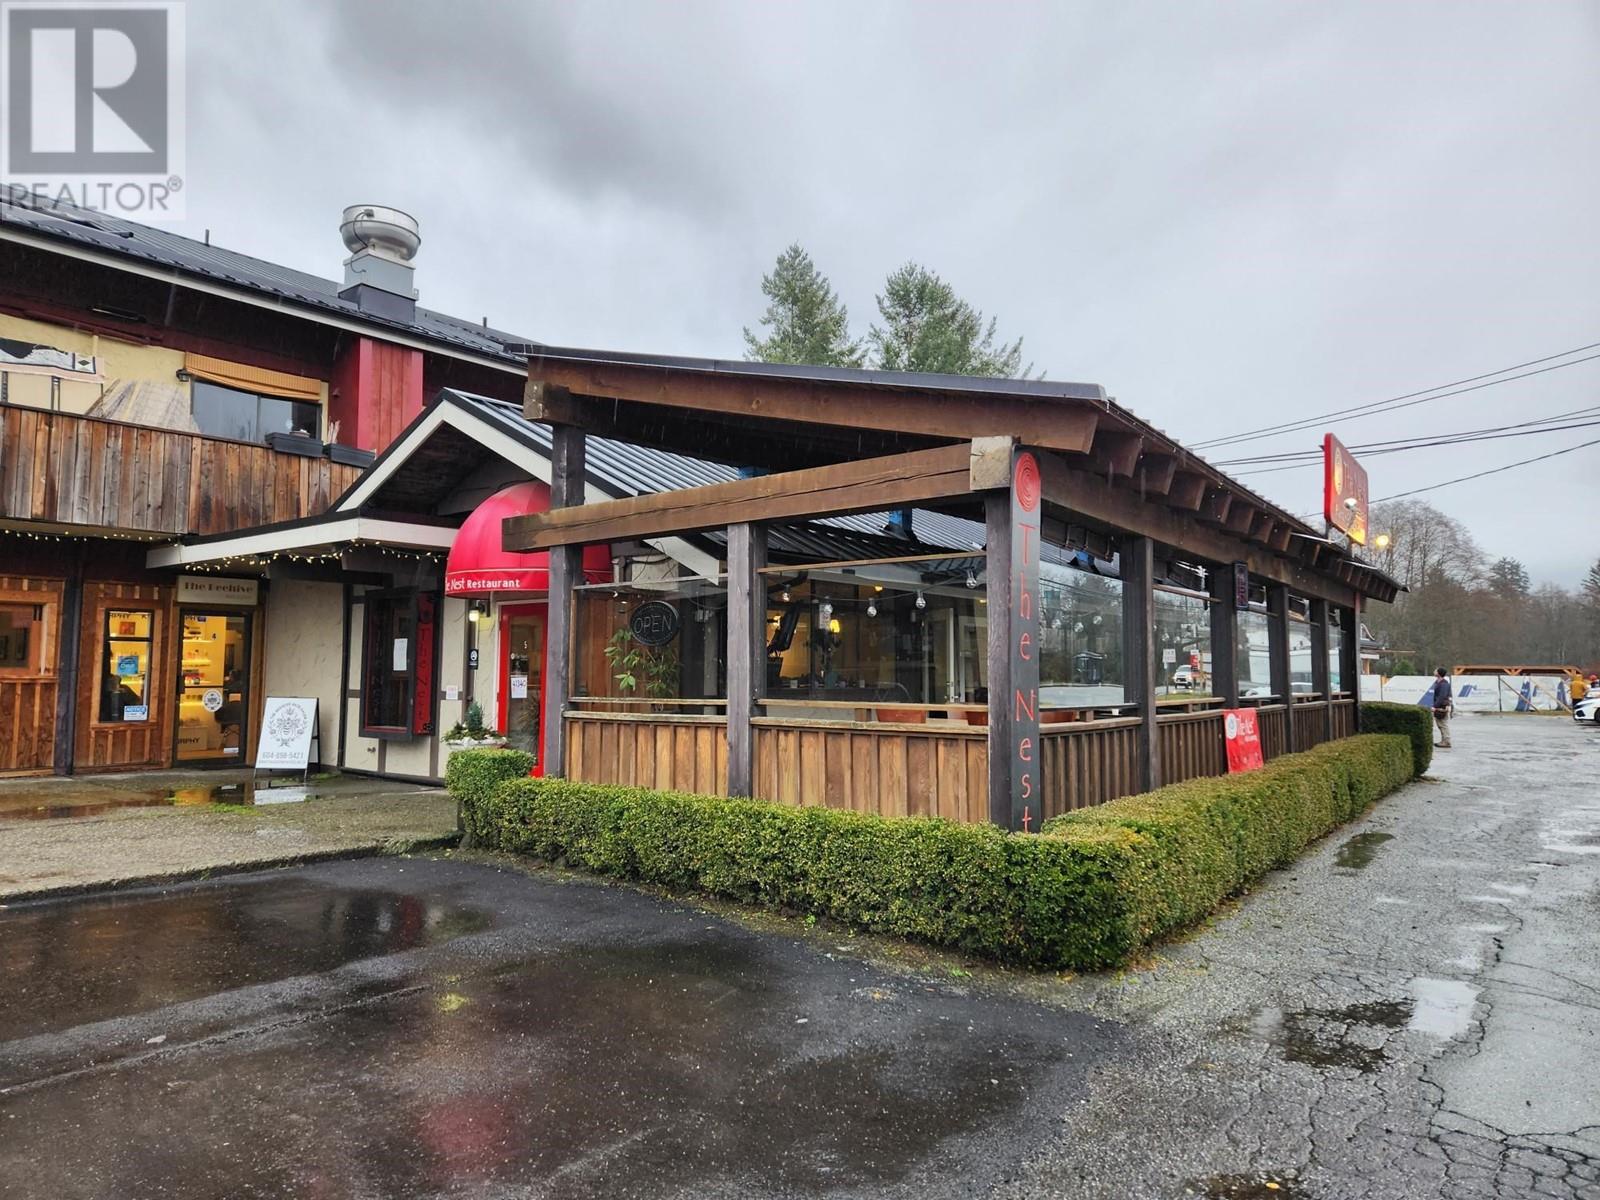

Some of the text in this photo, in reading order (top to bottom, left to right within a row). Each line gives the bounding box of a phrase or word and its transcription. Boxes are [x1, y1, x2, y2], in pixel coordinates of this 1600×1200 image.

[450, 577, 466, 591] Nest
[466, 579, 521, 590] Restaurant
[634, 615, 672, 634] OPEN
[1014, 522, 1037, 833] The Nest
